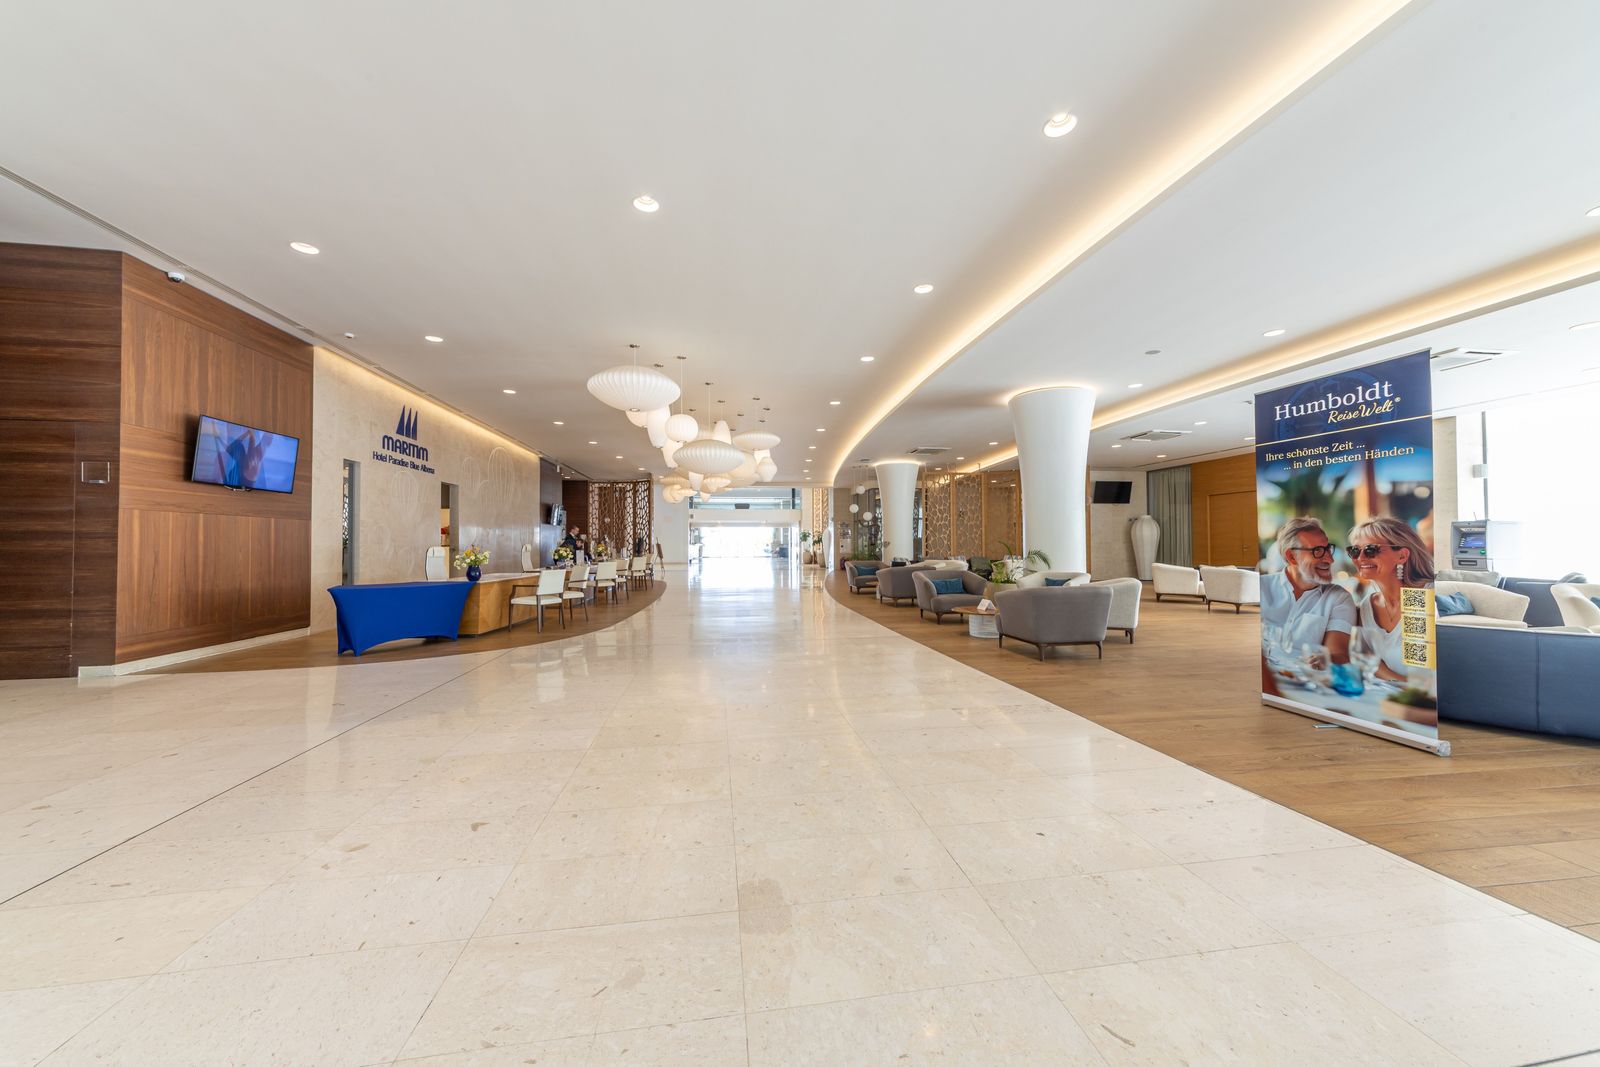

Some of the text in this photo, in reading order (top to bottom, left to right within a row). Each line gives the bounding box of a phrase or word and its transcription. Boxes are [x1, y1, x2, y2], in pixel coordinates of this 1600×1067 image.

[1274, 380, 1394, 421] Humboldt
[382, 434, 428, 462] MARITIM
[1265, 452, 1285, 462] Ihre
[1286, 446, 1329, 459] schönste
[1331, 441, 1354, 452] Zeit
[1293, 460, 1302, 469] in
[1304, 458, 1323, 468] den
[1325, 454, 1362, 464] besten
[1365, 446, 1414, 460] Händen
[372, 450, 388, 462] Hotel
[409, 460, 420, 471] Blue
